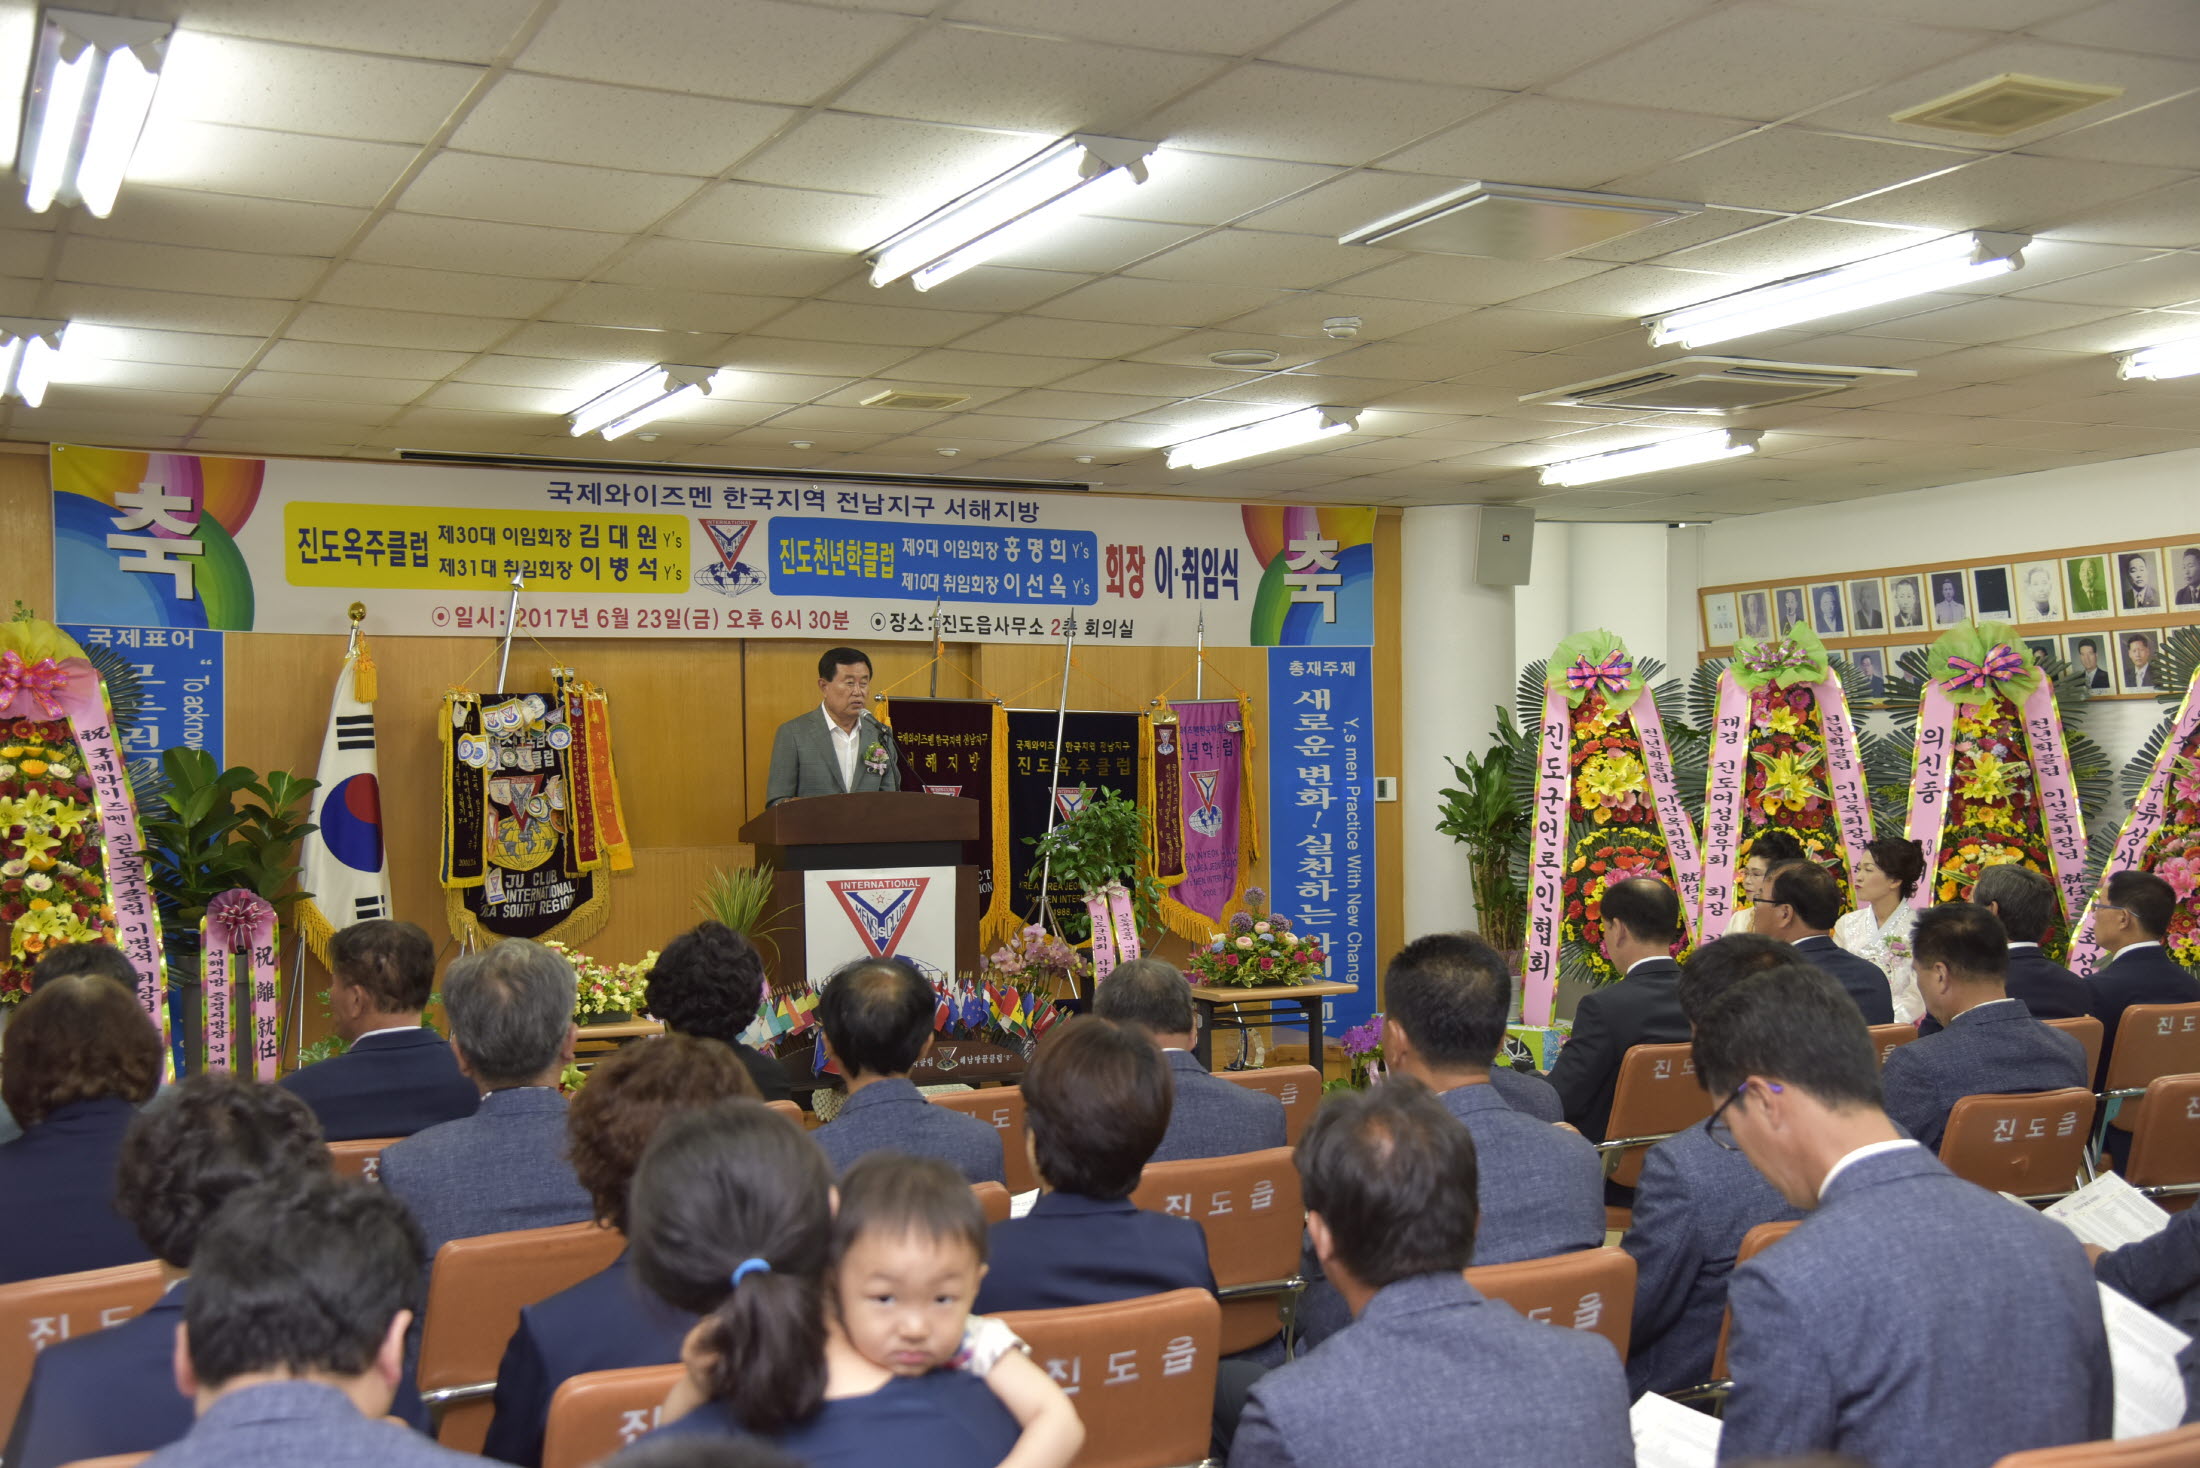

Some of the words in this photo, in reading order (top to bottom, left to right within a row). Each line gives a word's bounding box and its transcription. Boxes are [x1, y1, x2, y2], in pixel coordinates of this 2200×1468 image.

[547, 481, 713, 508] 국제와이즈멘
[723, 485, 826, 512] 한국지역
[836, 491, 935, 518] 전남지구
[944, 497, 1039, 523] 서해지방
[107, 482, 203, 600] 축
[298, 526, 429, 567] 진도옥주클럽
[437, 524, 496, 546] 제30대
[503, 525, 572, 548] 이임회장
[663, 532, 682, 548] Y's
[901, 537, 939, 558] 제9대
[943, 538, 999, 561] 이임회장
[1072, 543, 1090, 560] Y's
[438, 557, 496, 579] 제31대
[503, 558, 573, 581] 취임회장
[663, 565, 682, 581] Y's
[779, 536, 895, 579] 진도천년학클럽
[1104, 543, 1146, 599] 회장
[901, 571, 940, 593] 제10대
[943, 572, 999, 595] 취임회장
[1072, 579, 1091, 596] Y's
[1283, 532, 1344, 624] 축
[515, 607, 589, 629] 2017년
[596, 607, 629, 630] 6월
[637, 607, 719, 632] 23일(금)
[726, 609, 765, 630] 오후
[770, 608, 801, 631] 6시
[808, 609, 850, 630] 30분
[942, 613, 1045, 636] 진도읍사무소
[1084, 618, 1134, 639] 회의실
[87, 628, 194, 649] 국제표어
[184, 675, 210, 692] To
[1289, 660, 1356, 677] 총재주제
[80, 726, 110, 742] 祝
[183, 696, 210, 750] acknow
[1293, 688, 1335, 757] 새로운
[1719, 716, 1741, 745] 재경
[1016, 740, 1060, 751] 국제와이즈
[1642, 727, 1670, 784] 천년학클럽
[1346, 748, 1358, 781] men
[88, 747, 129, 826] 국제와이즈멘
[1346, 786, 1362, 850] Practice
[1708, 759, 1739, 868] 진도여성향우회
[1528, 721, 1566, 981] 진도군언론인협회
[110, 833, 147, 916] 진도옥주클럽
[532, 869, 558, 887] CLUB
[840, 880, 921, 890] INTERNATIONAL
[1295, 833, 1338, 925] 실천하는
[1346, 854, 1362, 889] With
[506, 881, 576, 904] INTERNATIONAL
[1704, 885, 1730, 917] 회장
[503, 903, 536, 918] SOUTH
[855, 904, 878, 939] MENS
[885, 903, 906, 939] CLUB
[1346, 893, 1362, 928] New
[125, 922, 153, 964] 이병석
[255, 945, 275, 969] 祝
[1346, 931, 1362, 983] Chang
[207, 949, 228, 988] 서해지방
[257, 1015, 277, 1062] 就任
